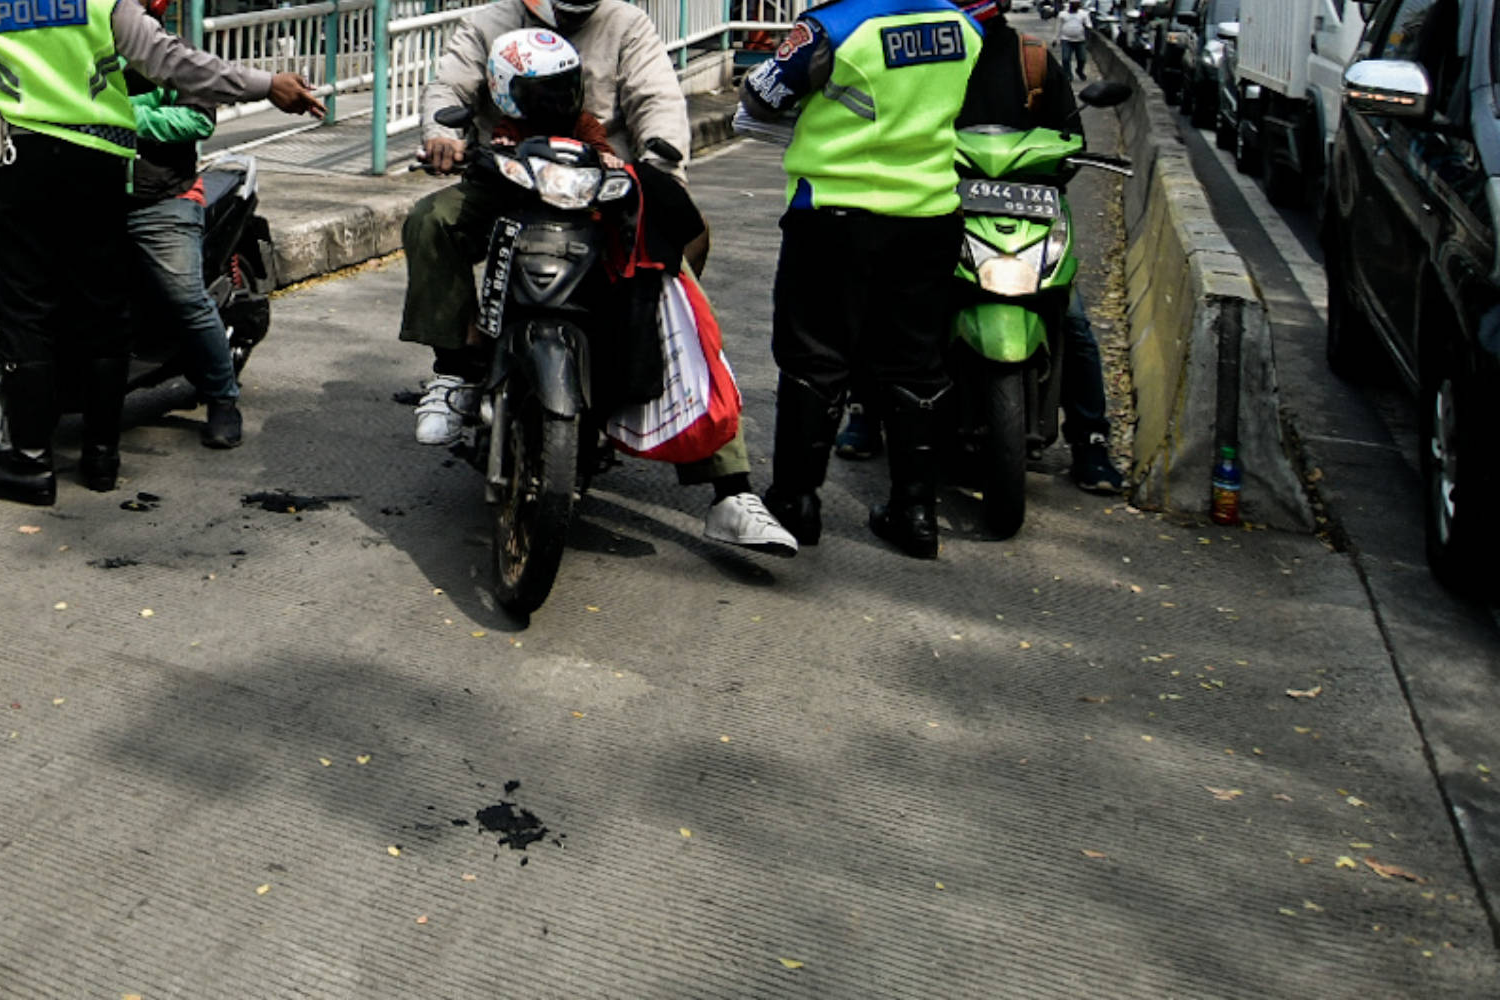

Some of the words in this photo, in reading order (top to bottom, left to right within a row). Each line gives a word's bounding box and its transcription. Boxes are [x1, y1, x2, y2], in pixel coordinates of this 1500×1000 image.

[886, 25, 963, 60] POLISI
[969, 183, 1012, 198] 4944
[1020, 186, 1055, 203] TXA
